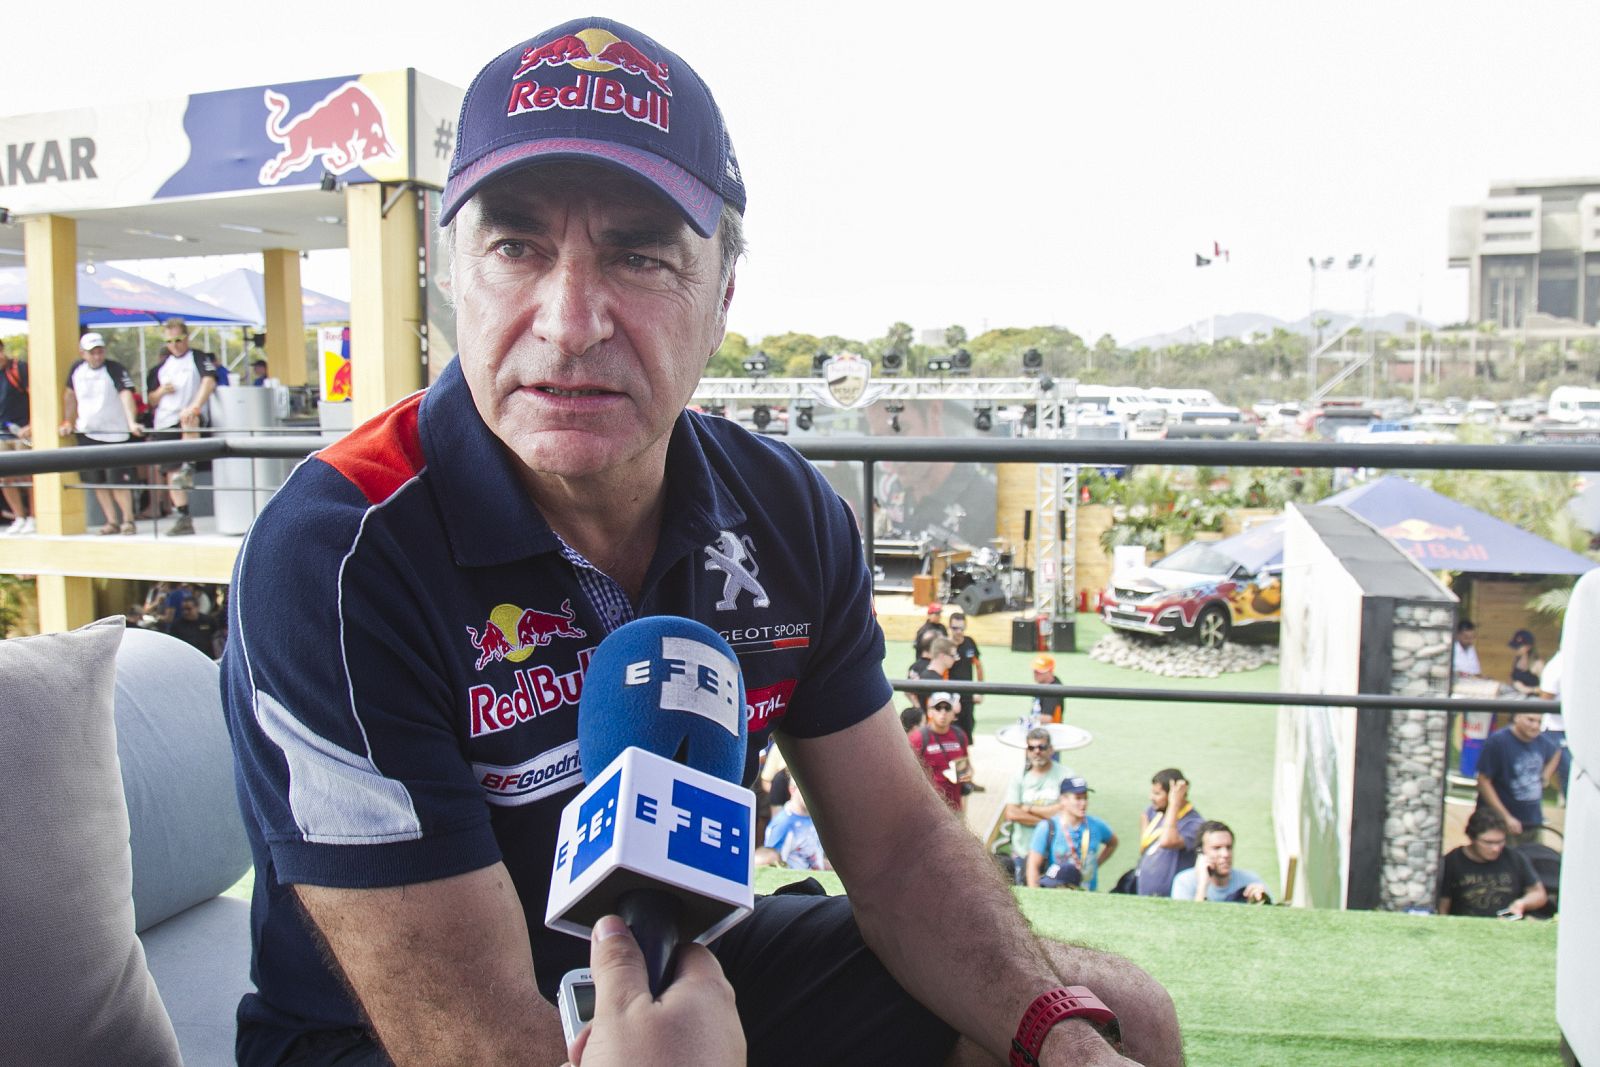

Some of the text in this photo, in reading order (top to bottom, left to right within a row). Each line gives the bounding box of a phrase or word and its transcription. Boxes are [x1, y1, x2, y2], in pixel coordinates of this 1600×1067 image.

[507, 74, 670, 133] Red Bull
[0, 136, 98, 187] KAR
[774, 622, 812, 638] SPORT
[468, 646, 598, 738] Red Bu
[480, 749, 582, 791] BFGoodri
